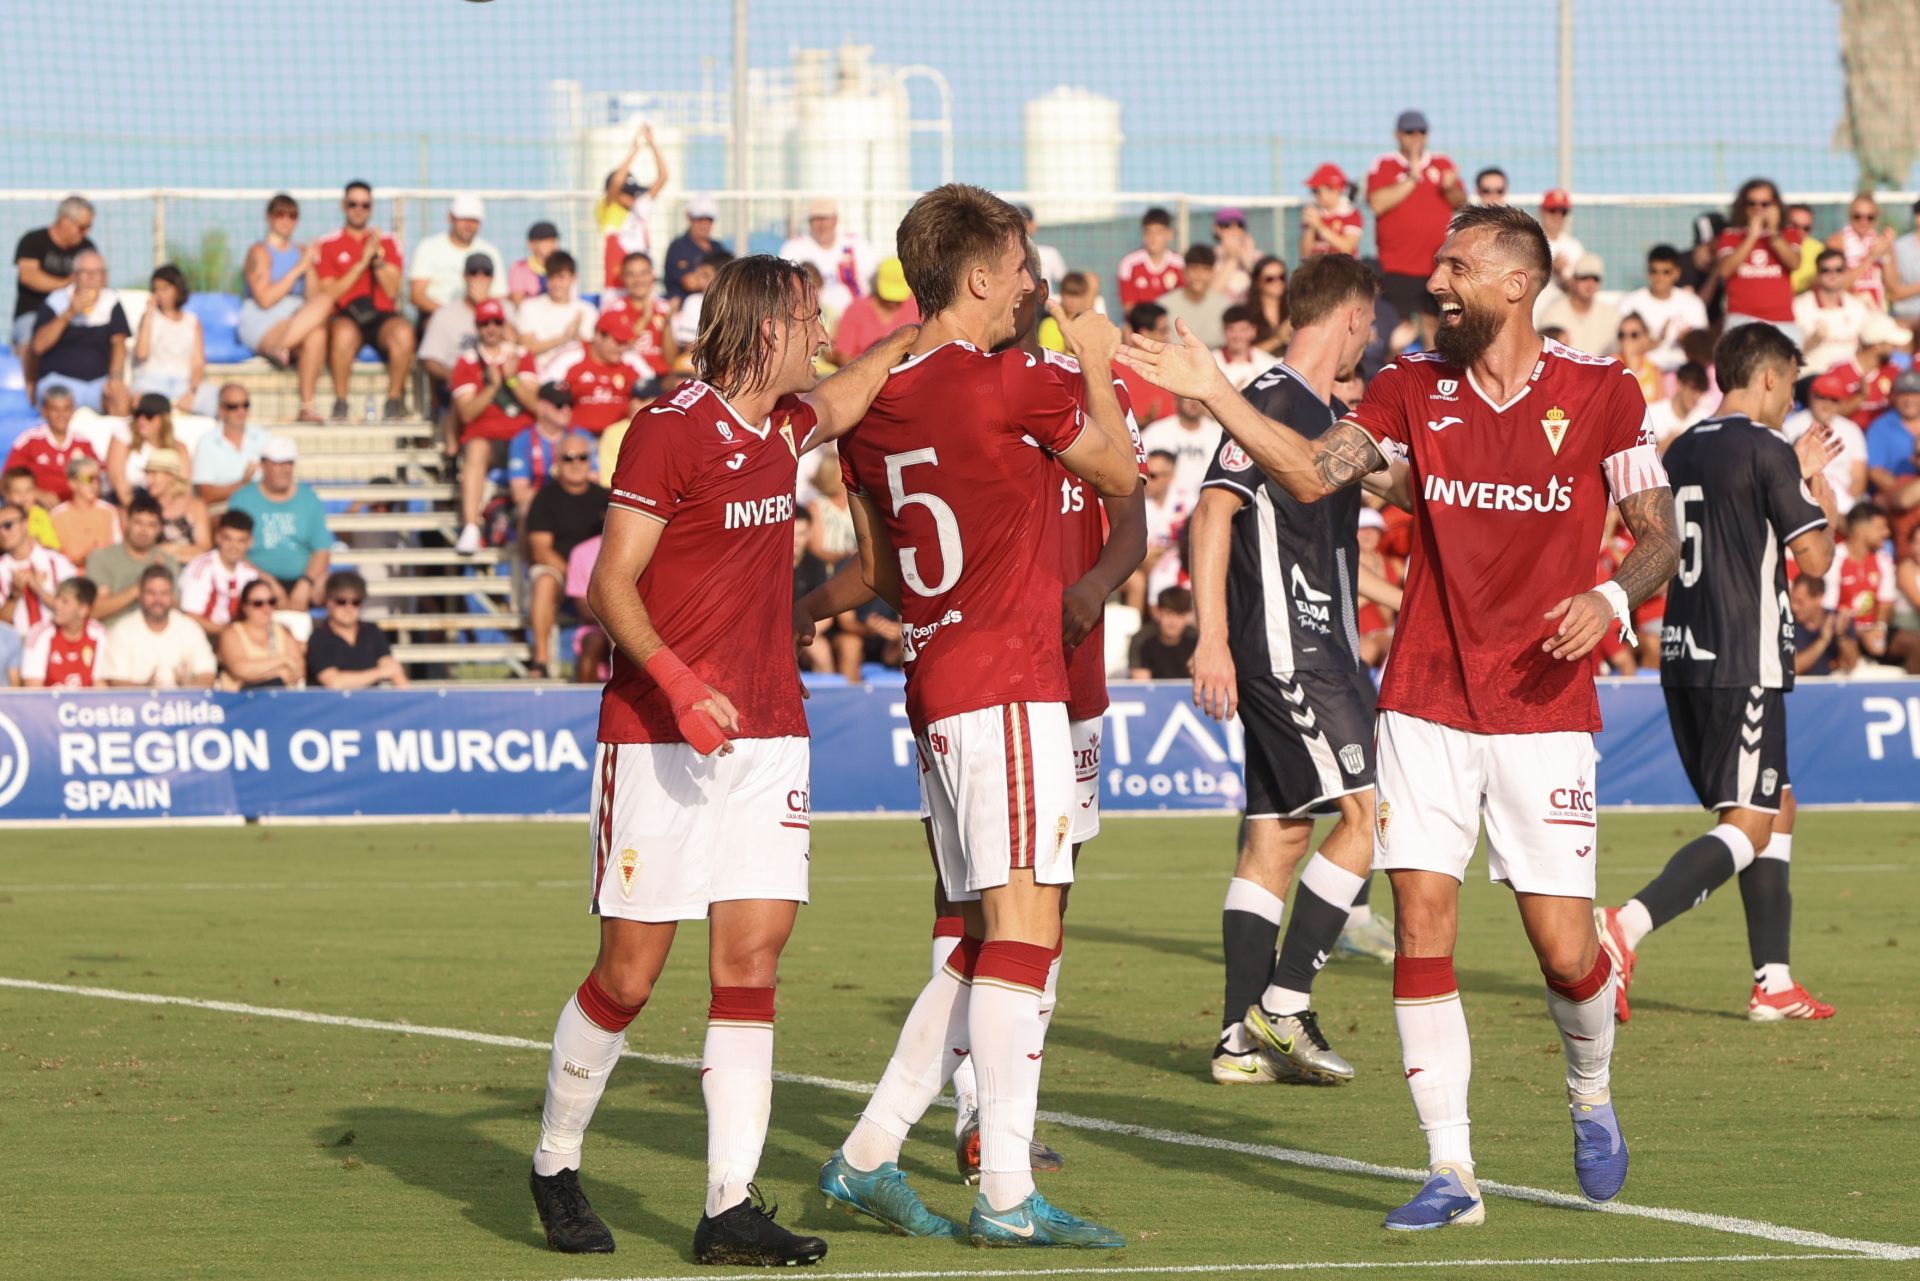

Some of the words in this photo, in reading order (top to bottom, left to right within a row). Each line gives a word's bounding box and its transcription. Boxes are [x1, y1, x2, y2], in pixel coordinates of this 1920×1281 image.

[1424, 474, 1572, 512] INVERSUS
[884, 447, 963, 597] 5
[58, 702, 136, 728] Costa
[140, 699, 225, 726] Cálida
[58, 728, 270, 775] REGION
[289, 729, 361, 773] OF
[376, 728, 588, 773] MURCIA
[63, 779, 171, 811] SPAIN
[1549, 787, 1593, 812] CRC
